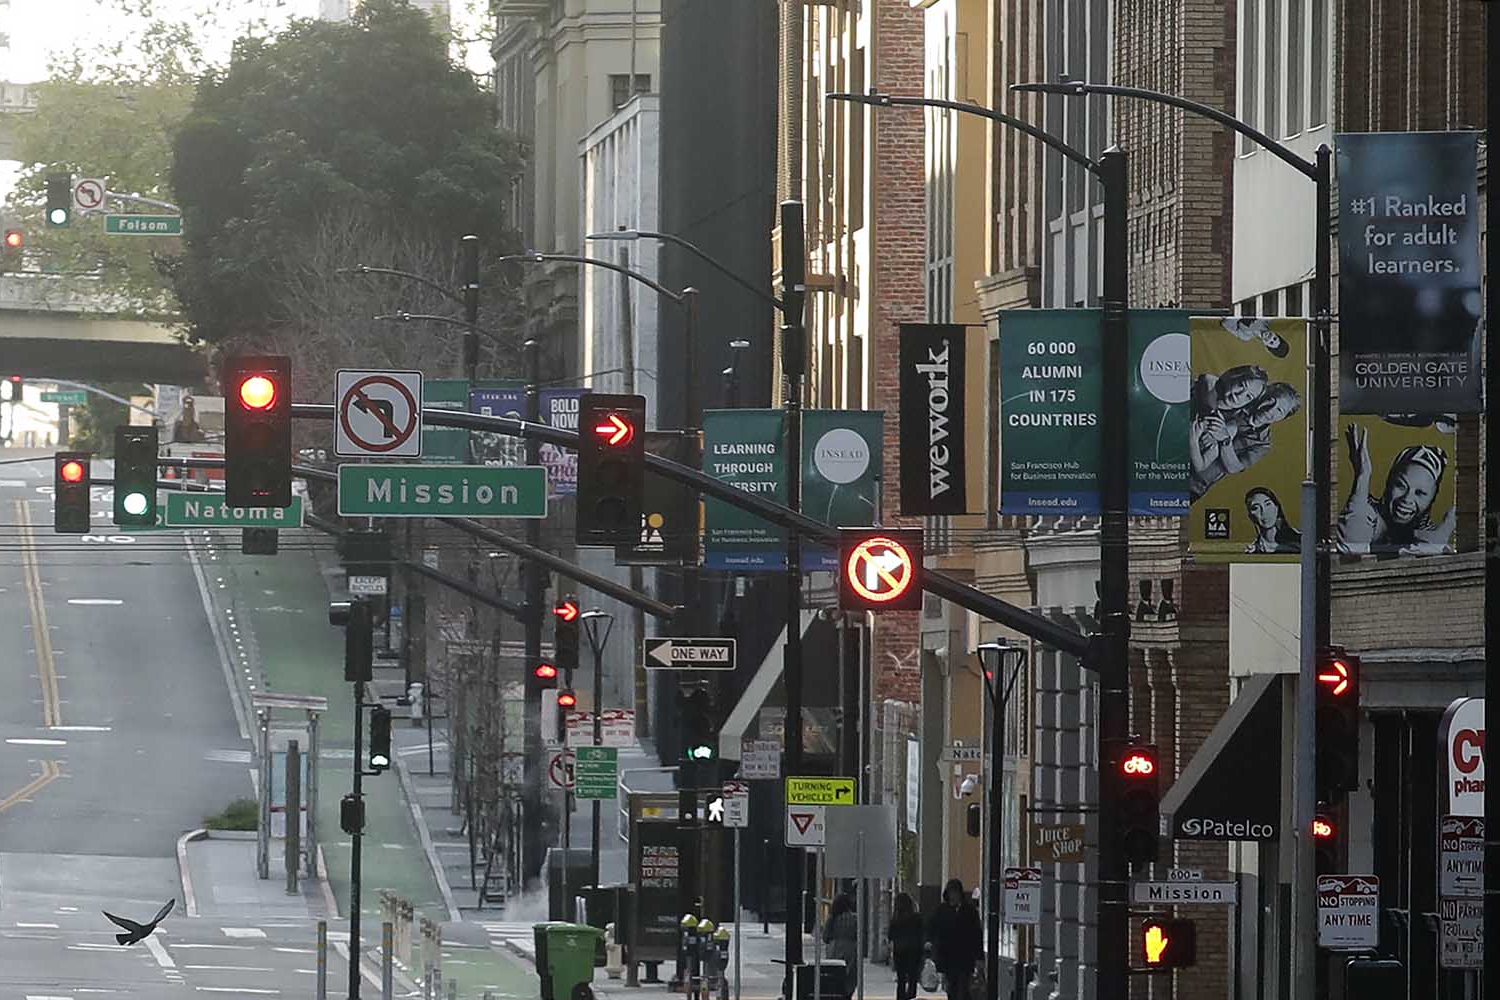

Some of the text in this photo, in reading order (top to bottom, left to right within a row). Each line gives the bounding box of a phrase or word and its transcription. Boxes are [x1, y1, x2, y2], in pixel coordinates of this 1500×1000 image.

[1351, 194, 1467, 217] #1 Ranked
[118, 219, 168, 231] Folsom
[1364, 224, 1457, 246] for adult
[1368, 253, 1461, 274] learners.
[1027, 342, 1077, 355] 60 000
[1021, 365, 1082, 379] ALUMNI
[1149, 360, 1190, 372] INSEA
[1355, 361, 1468, 375] GOLDEN GATE
[1355, 375, 1468, 389] UNIVERSITY
[1029, 389, 1077, 403] IN 175
[550, 399, 579, 413] BOLD
[550, 413, 579, 428] NOW
[916, 341, 950, 499] wework
[1008, 413, 1098, 427] COUNTRIES
[713, 443, 776, 455] LEARNING
[820, 449, 864, 459] INSEAD
[713, 463, 773, 473] THROUGH
[1010, 461, 1080, 470] San Francisco Hub
[1134, 461, 1186, 471] The Business
[1010, 472, 1097, 481] for Business Innovation
[1135, 472, 1186, 480] for the World
[366, 478, 519, 504] Mission
[731, 481, 778, 493] ERSITY
[184, 501, 286, 520] Natoma
[82, 535, 136, 544] NO
[671, 648, 725, 660] ONE WAY
[953, 749, 981, 759] Nato
[792, 782, 832, 791] TURNING
[791, 794, 833, 802] VEHICLES
[1203, 819, 1273, 838] Patelco
[1036, 827, 1071, 846] JUICE
[1052, 839, 1082, 858] SHOP
[1443, 840, 1458, 850] NO
[1446, 859, 1484, 873] ANY TIM
[1170, 870, 1191, 881] 600
[1149, 886, 1223, 900] Mission
[1320, 896, 1376, 907] NO STOPPING
[1442, 901, 1456, 918] NO
[1325, 914, 1372, 926] ANY TIME
